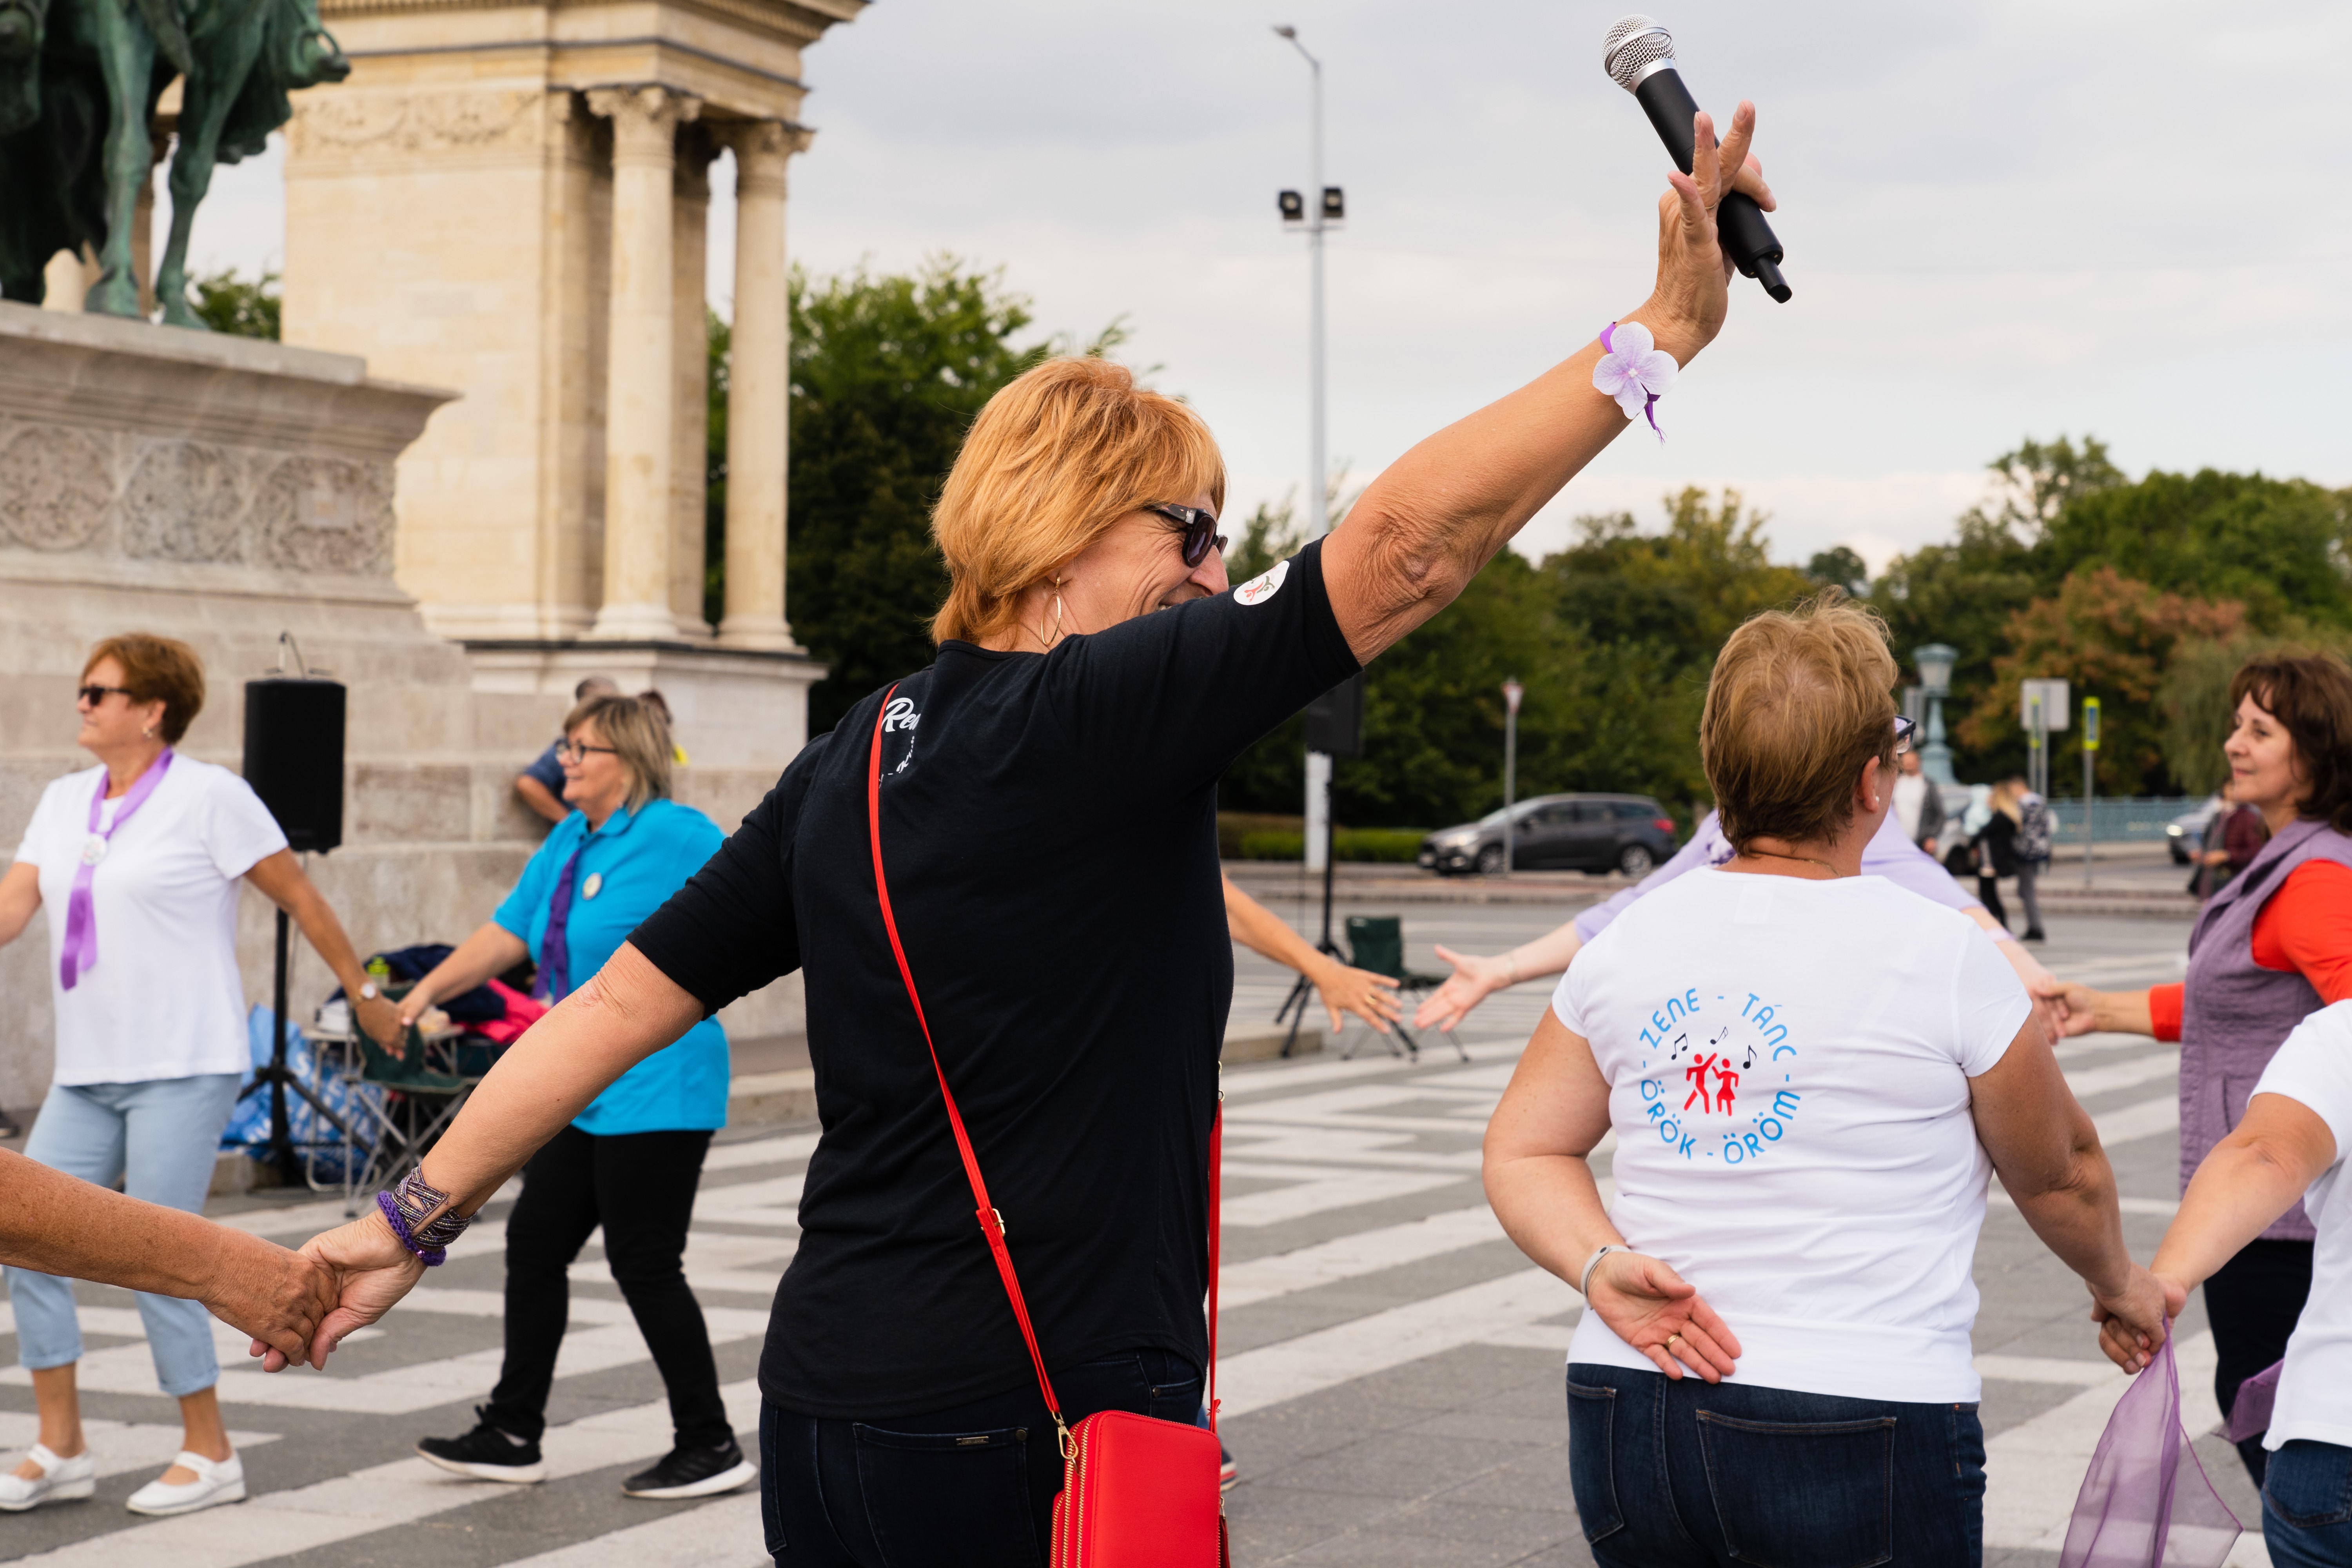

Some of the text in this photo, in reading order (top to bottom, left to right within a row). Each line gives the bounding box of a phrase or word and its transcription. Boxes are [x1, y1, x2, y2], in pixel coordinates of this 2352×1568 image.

[1639, 988, 1700, 1049] ZENE
[1741, 993, 1797, 1062] TÁNC
[1641, 1080, 1697, 1160] ÖRÖK
[1722, 1091, 1800, 1164] ÖRÖM
